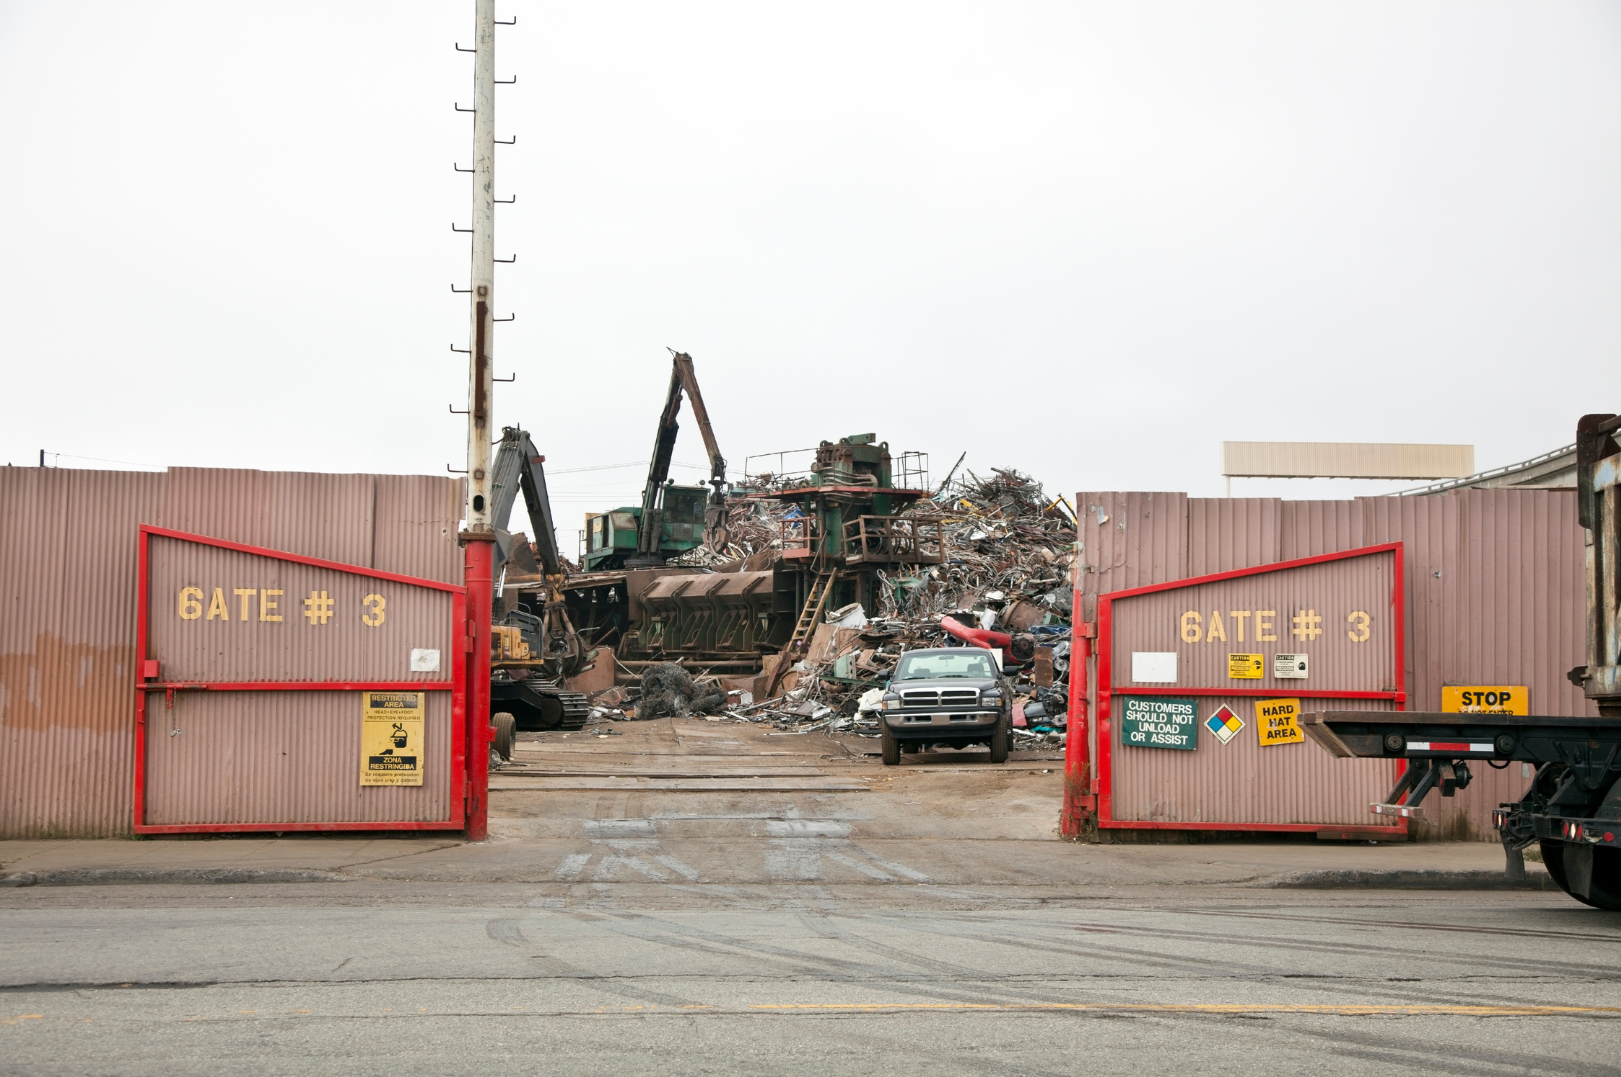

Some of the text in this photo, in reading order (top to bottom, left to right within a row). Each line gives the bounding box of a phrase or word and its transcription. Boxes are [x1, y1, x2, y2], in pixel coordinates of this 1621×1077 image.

[304, 590, 334, 625] #
[362, 593, 386, 626] 3
[1292, 610, 1322, 642] #
[1348, 610, 1370, 642] 3
[1462, 691, 1512, 706] STOP
[1128, 700, 1192, 714] CUSTOMERS
[1262, 705, 1294, 716] HARD
[1126, 710, 1194, 724] SHOULD NOT
[1269, 717, 1290, 727] HAT
[1138, 722, 1180, 734] UNLOAD
[1267, 728, 1296, 739] AREA
[1130, 732, 1188, 745] OR ASSIST
